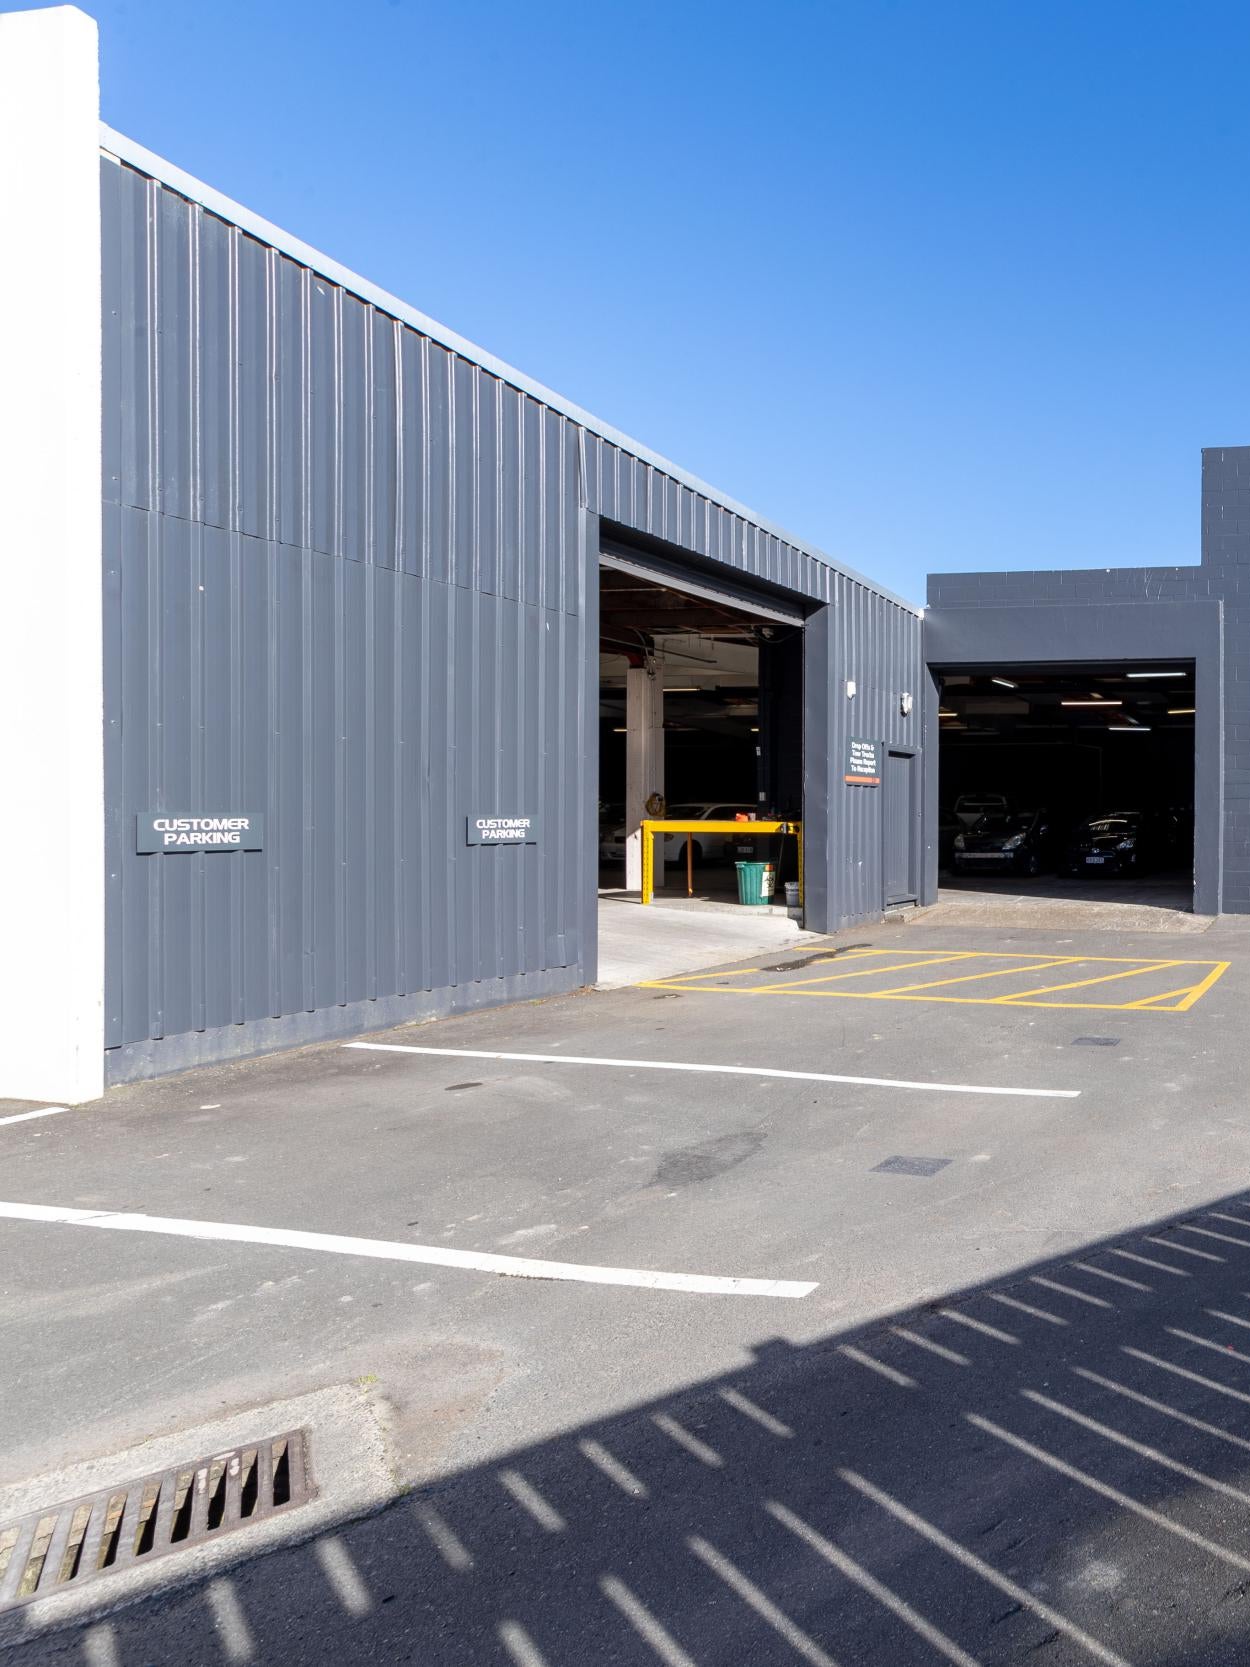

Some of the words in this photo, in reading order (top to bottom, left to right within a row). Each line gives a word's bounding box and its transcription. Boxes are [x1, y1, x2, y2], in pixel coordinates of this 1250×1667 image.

[851, 741, 862, 750] Drop
[861, 750, 875, 759] Trucks
[850, 756, 863, 765] Please
[863, 758, 876, 767] Report
[851, 764, 856, 772] To
[857, 765, 876, 774] Reception
[153, 818, 250, 832] CUSTOMER
[476, 818, 531, 829] CUSTOMER
[163, 831, 241, 846] PARKING
[482, 829, 526, 839] PARKING
